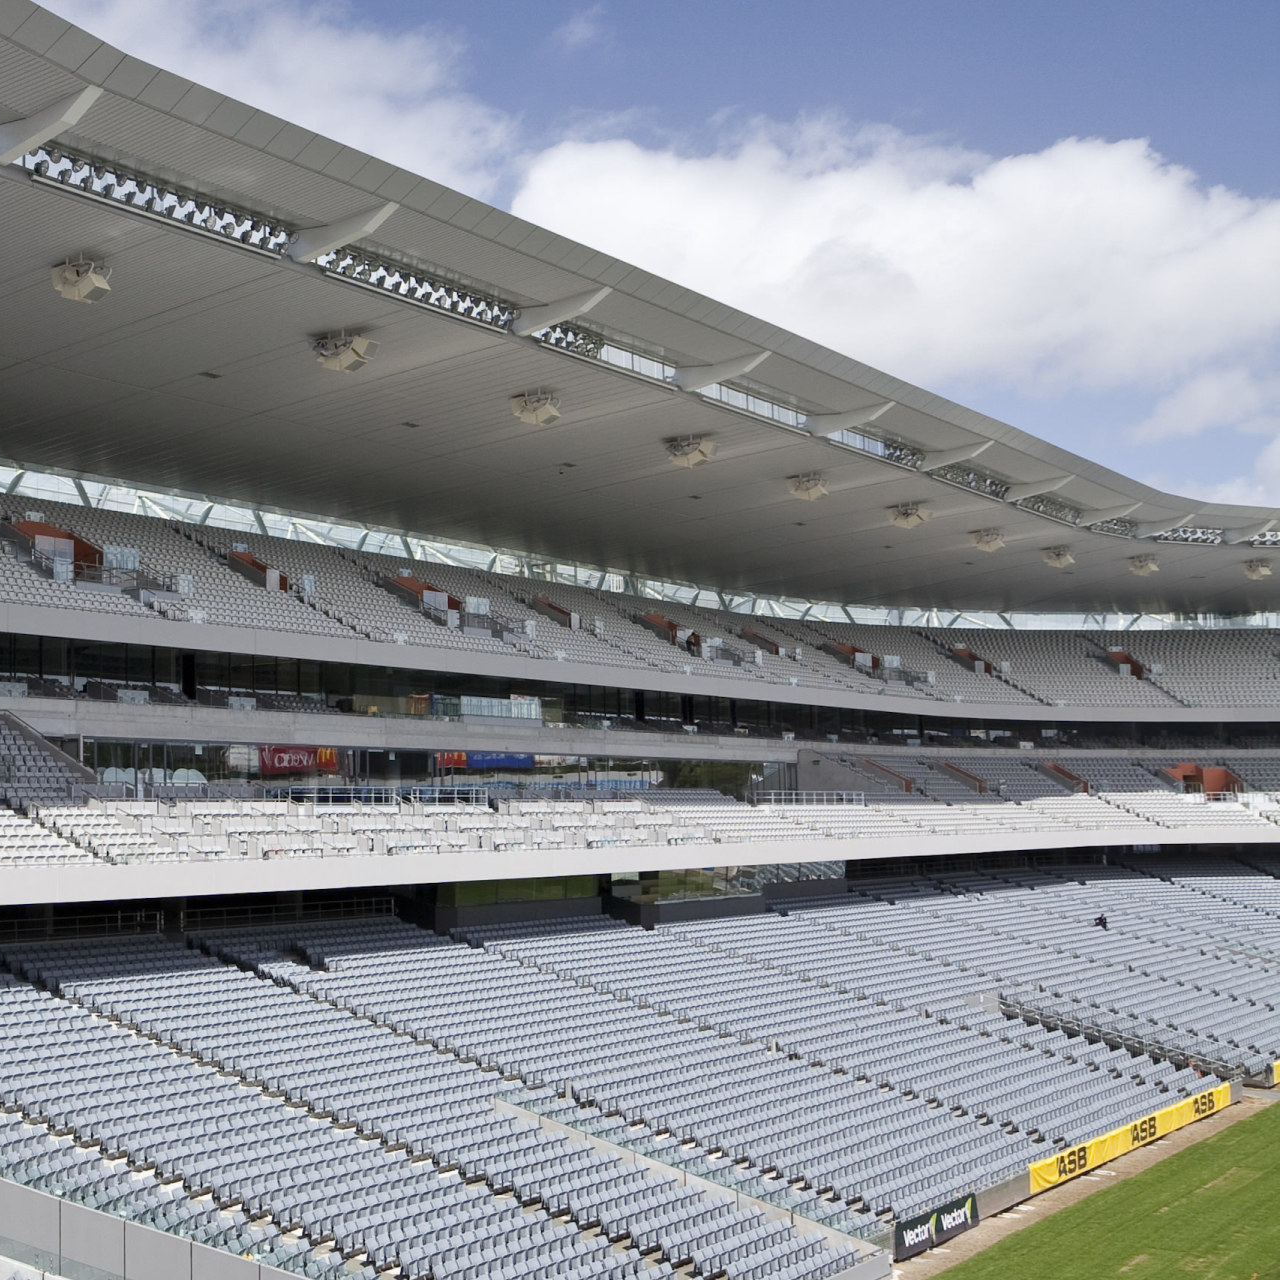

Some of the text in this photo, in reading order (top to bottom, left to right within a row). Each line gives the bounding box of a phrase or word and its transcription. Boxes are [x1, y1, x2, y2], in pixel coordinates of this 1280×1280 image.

[1193, 1092, 1215, 1117] ASB
[1131, 1117, 1157, 1145] ASB
[1057, 1146, 1087, 1177] ASB
[941, 1207, 967, 1231] Vector
[903, 1223, 930, 1247] Vector
